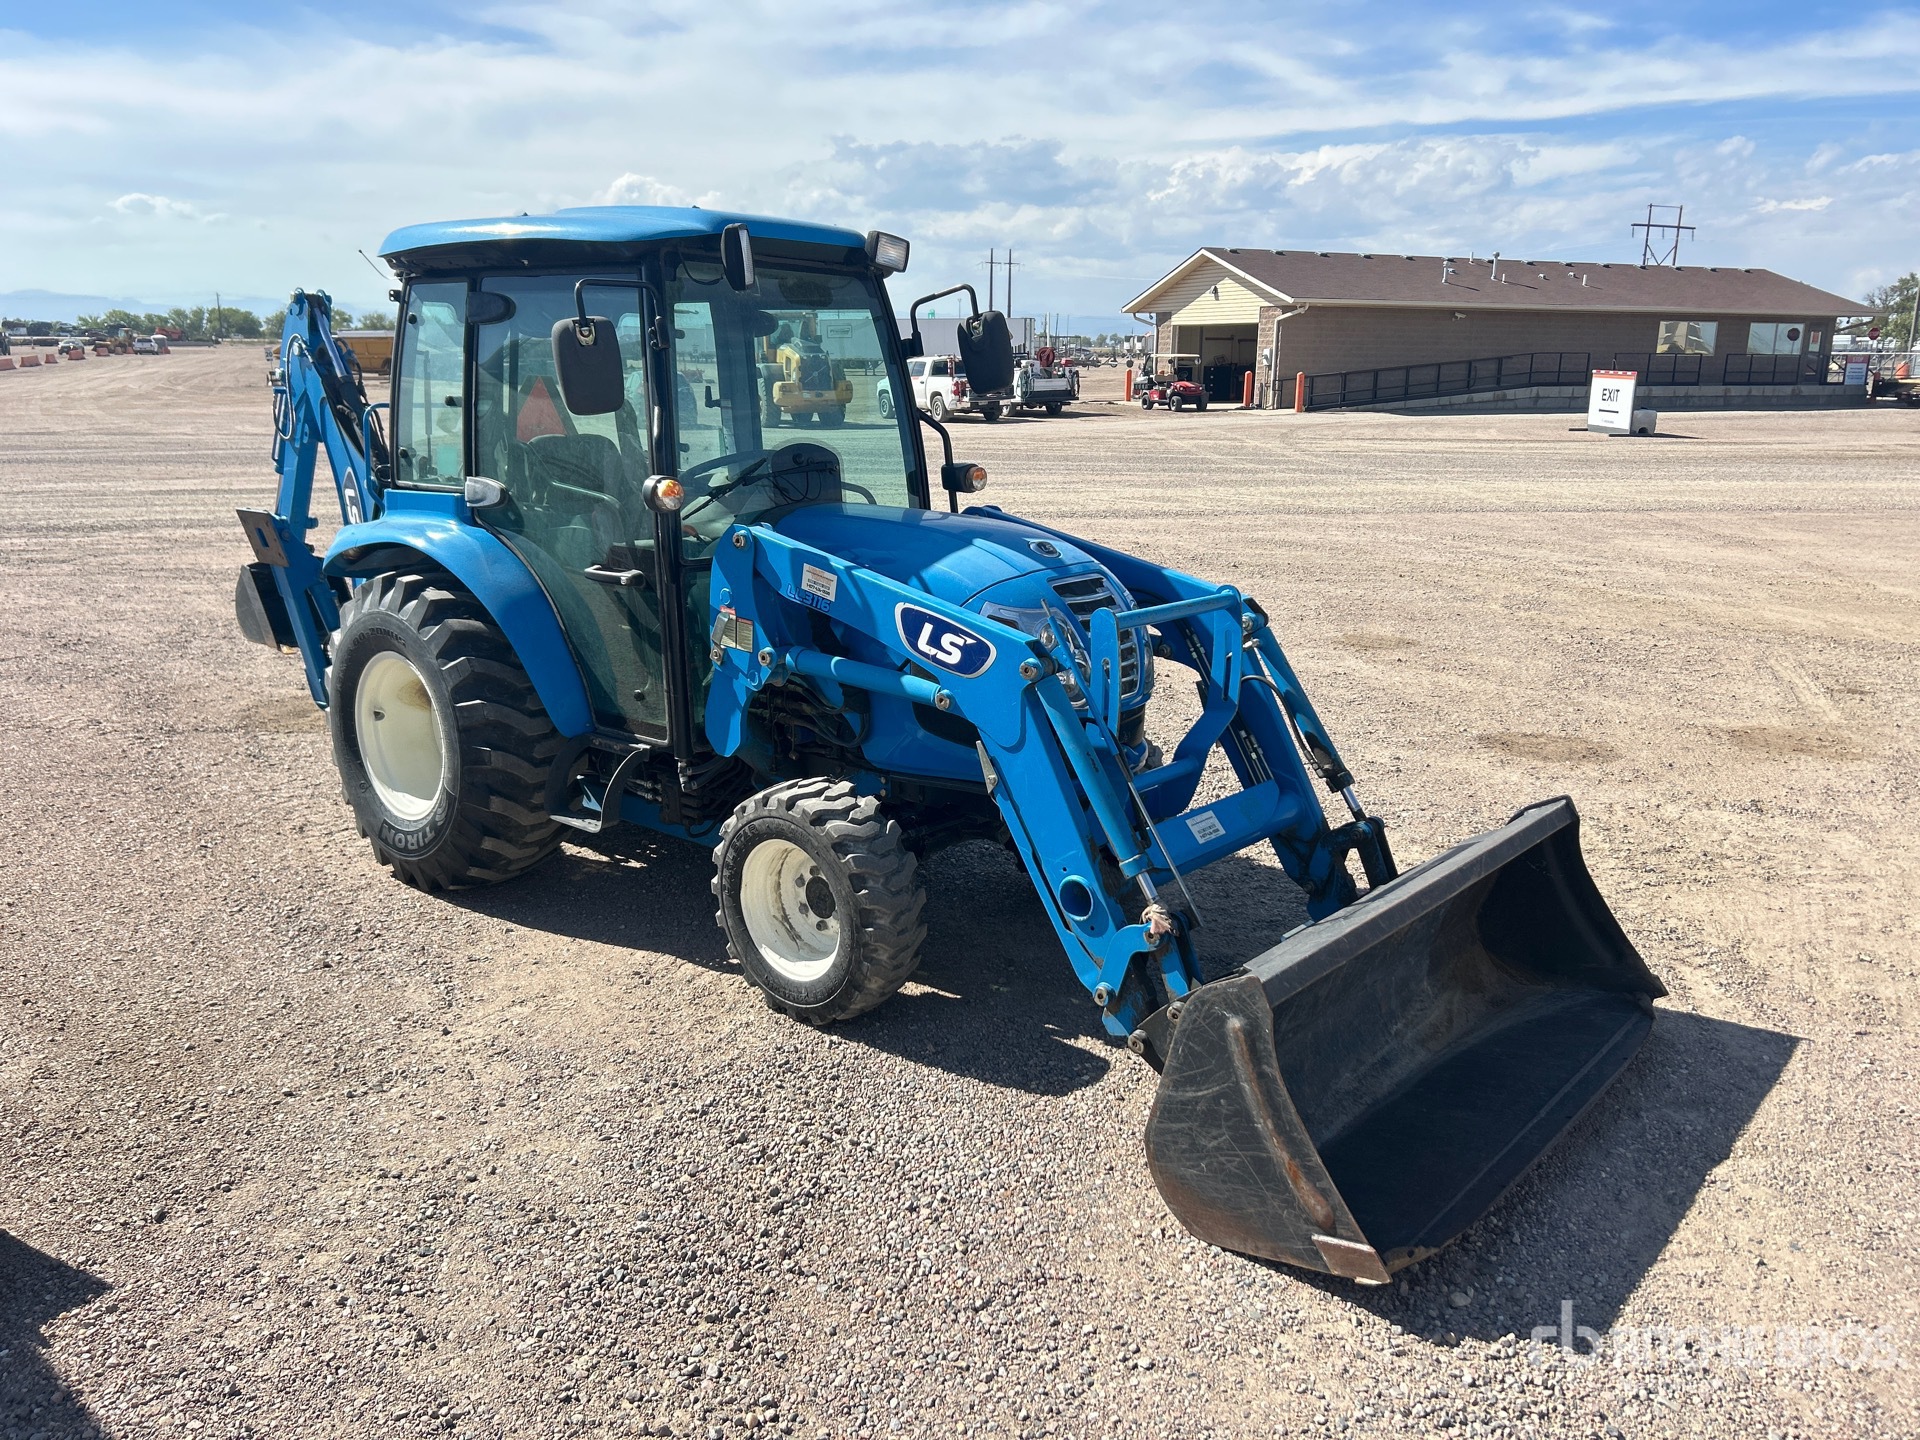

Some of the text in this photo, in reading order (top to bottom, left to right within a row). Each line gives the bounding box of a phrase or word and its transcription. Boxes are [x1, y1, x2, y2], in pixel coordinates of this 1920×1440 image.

[1601, 388, 1620, 402] EXIT
[344, 488, 360, 525] LS
[1041, 544, 1054, 552] LS
[917, 622, 970, 665] LS
[381, 823, 436, 850] TIRON
